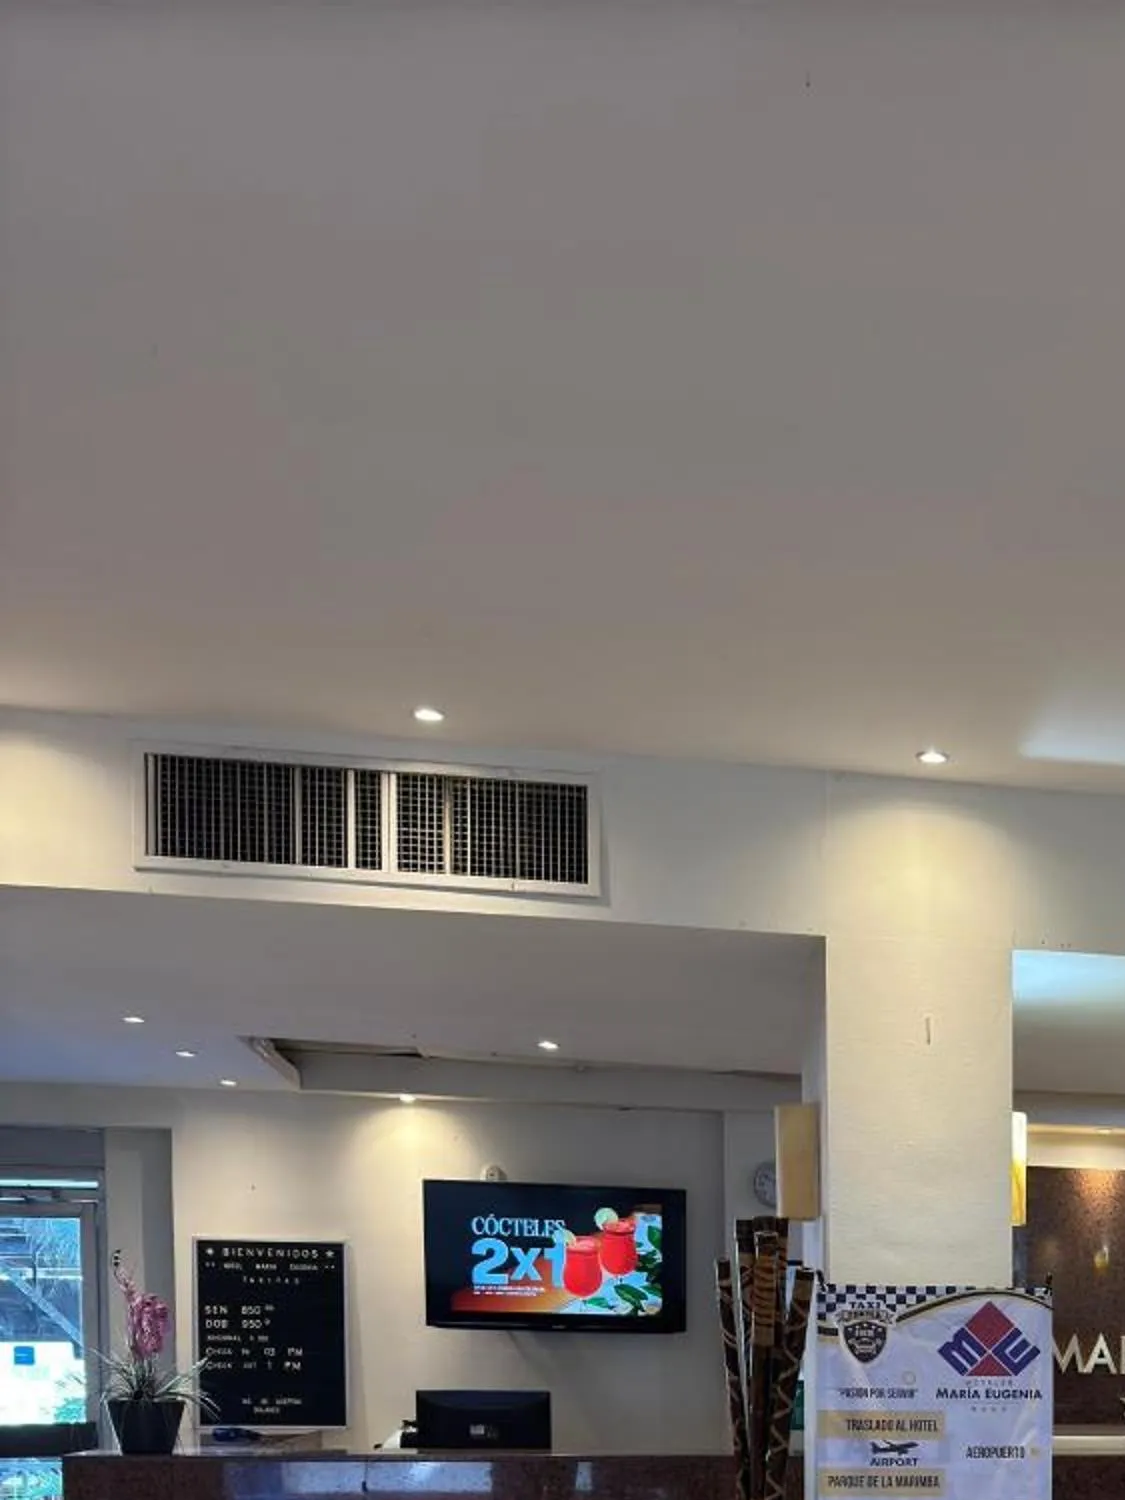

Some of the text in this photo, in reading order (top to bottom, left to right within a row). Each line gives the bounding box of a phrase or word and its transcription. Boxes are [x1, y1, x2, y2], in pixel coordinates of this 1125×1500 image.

[471, 1213, 566, 1238] CÓCTELES
[222, 1247, 319, 1259] BIENVENIDOS
[849, 1301, 881, 1309] TAXI
[936, 1387, 1043, 1400] MARÍA EUGENIA
[847, 1419, 938, 1431] TRASLADO AL HOTEL
[965, 1446, 1025, 1459] AEROPUERTO
[869, 1457, 918, 1467] AIRPORT
[828, 1475, 940, 1488] PARQUE DE LA MARIMBA
